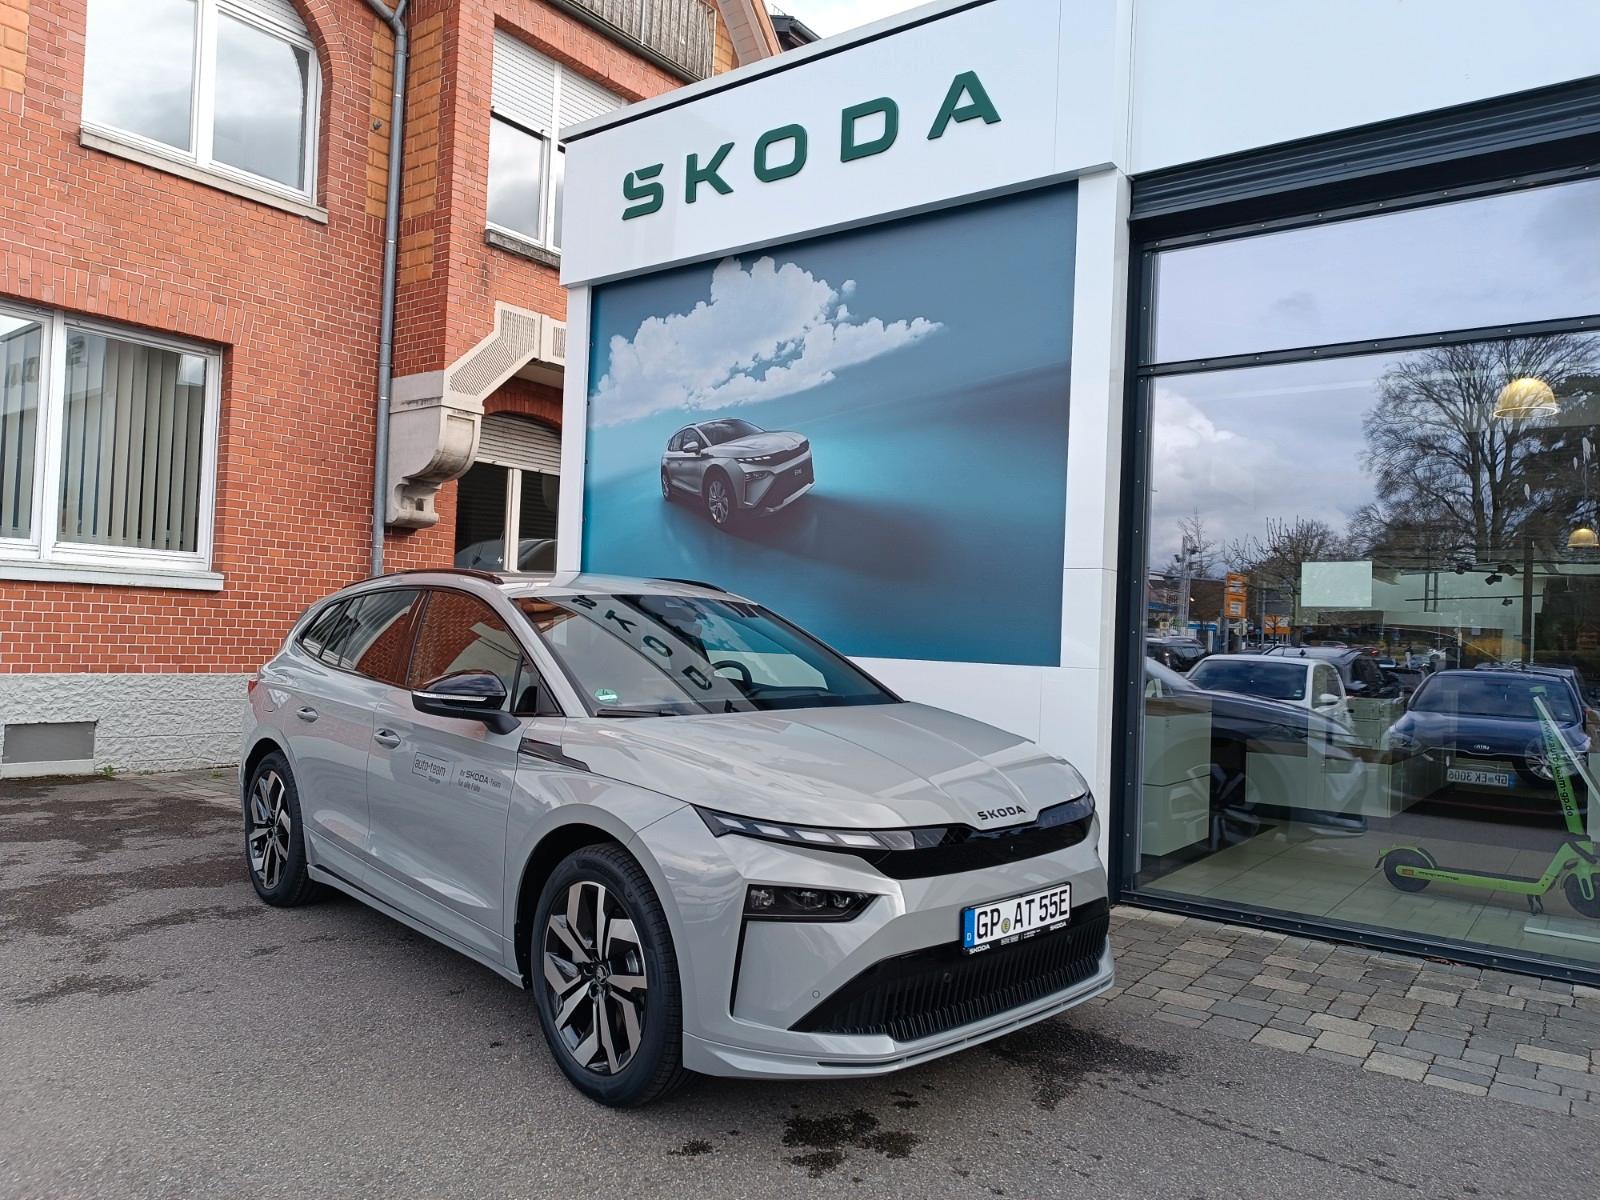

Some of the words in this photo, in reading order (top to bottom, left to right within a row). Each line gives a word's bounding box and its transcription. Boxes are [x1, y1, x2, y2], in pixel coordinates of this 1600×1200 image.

[622, 70, 1002, 221] SKODA
[976, 805, 1026, 820] SKODA
[976, 907, 1001, 940] GP
[1013, 898, 1036, 931] AT
[1039, 889, 1068, 922] 55E
[966, 932, 972, 941] D
